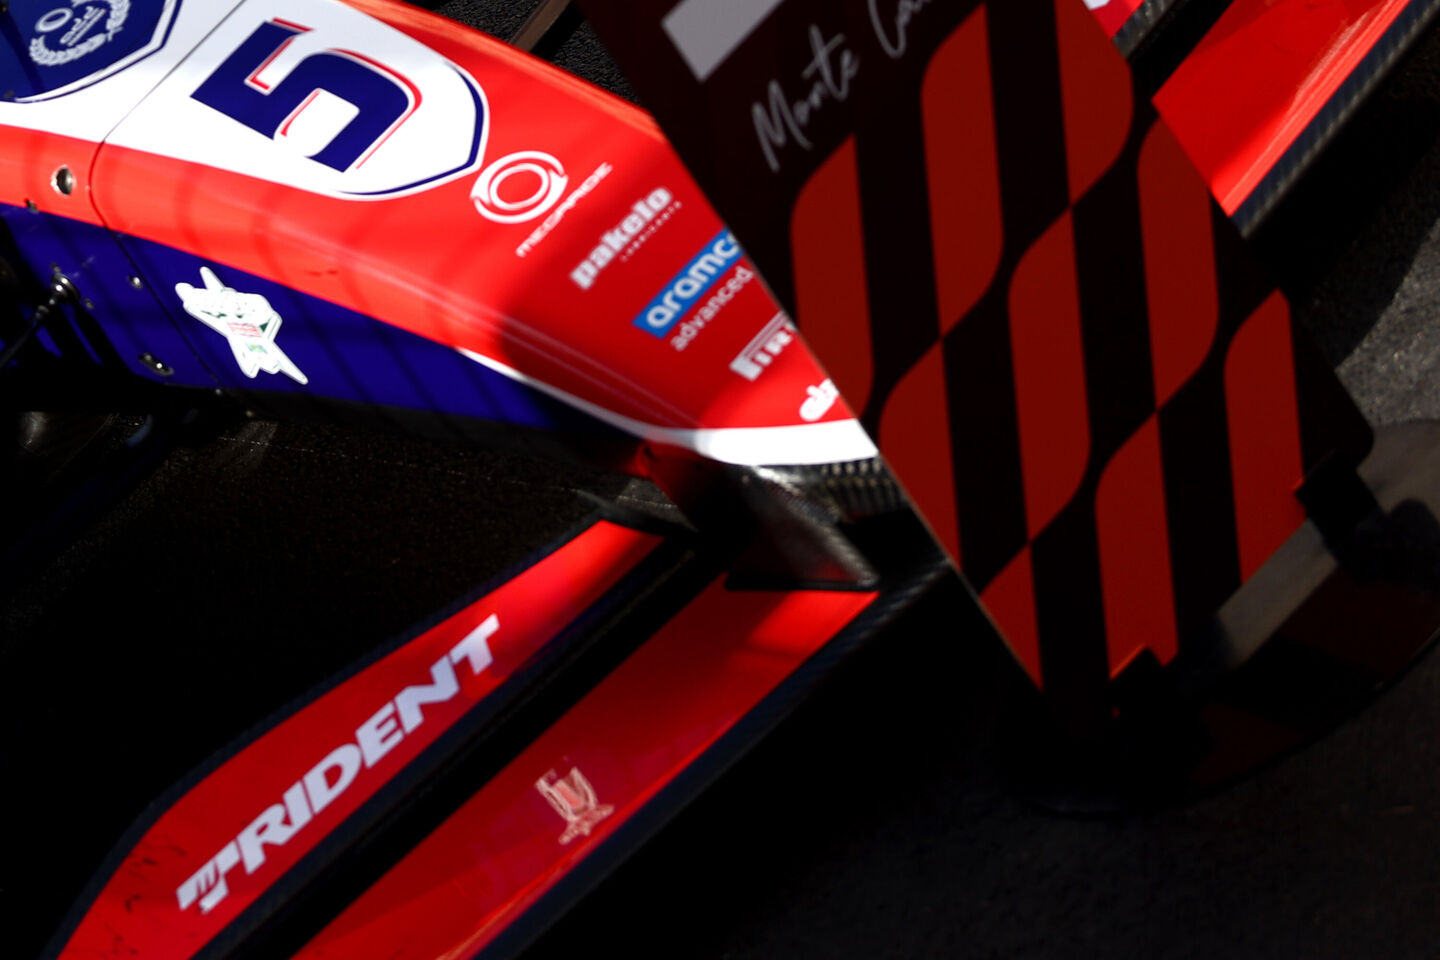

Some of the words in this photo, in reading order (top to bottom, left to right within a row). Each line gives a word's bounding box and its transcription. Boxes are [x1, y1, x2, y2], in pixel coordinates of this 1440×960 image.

[190, 17, 423, 173] 5
[752, 23, 859, 173] Monte
[570, 187, 673, 291] pakelo
[645, 232, 741, 329] aramc
[670, 265, 755, 352] advanced
[176, 613, 501, 915] TRIDENT
